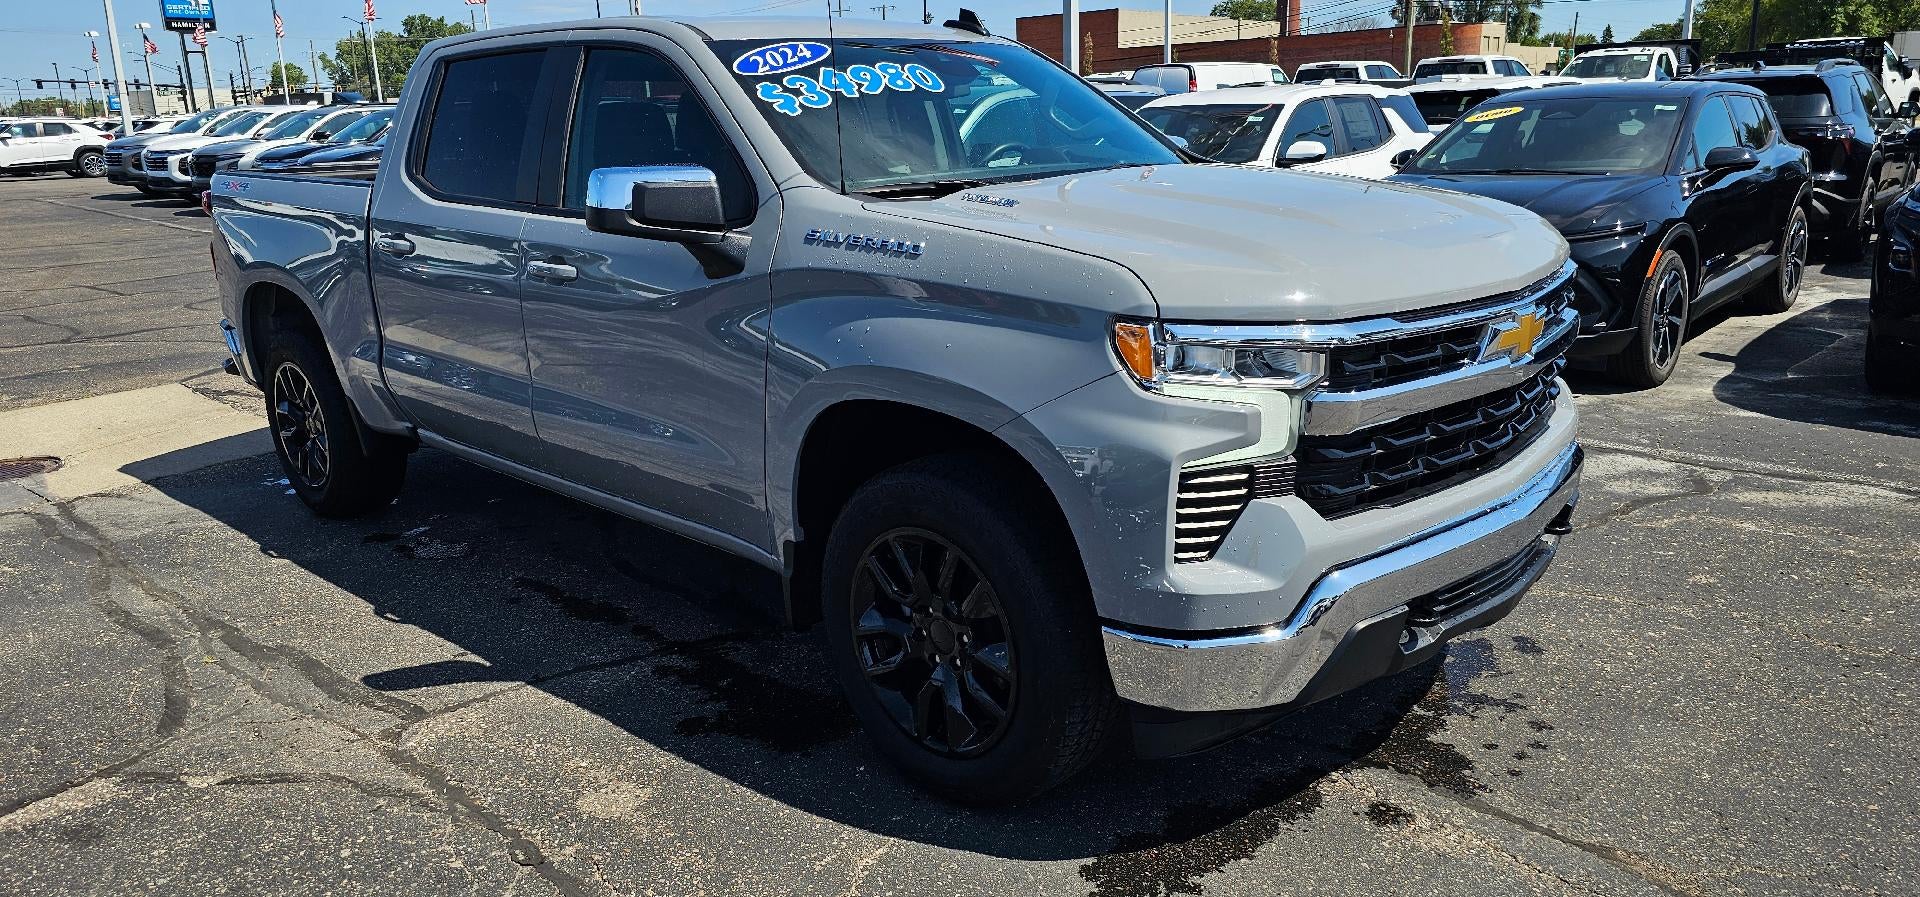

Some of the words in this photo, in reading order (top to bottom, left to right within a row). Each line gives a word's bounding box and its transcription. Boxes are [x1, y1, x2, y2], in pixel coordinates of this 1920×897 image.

[171, 21, 211, 29] HAMILTN
[749, 43, 812, 73] 2024
[756, 62, 945, 116] $34980
[804, 228, 926, 256] SILVERADO
